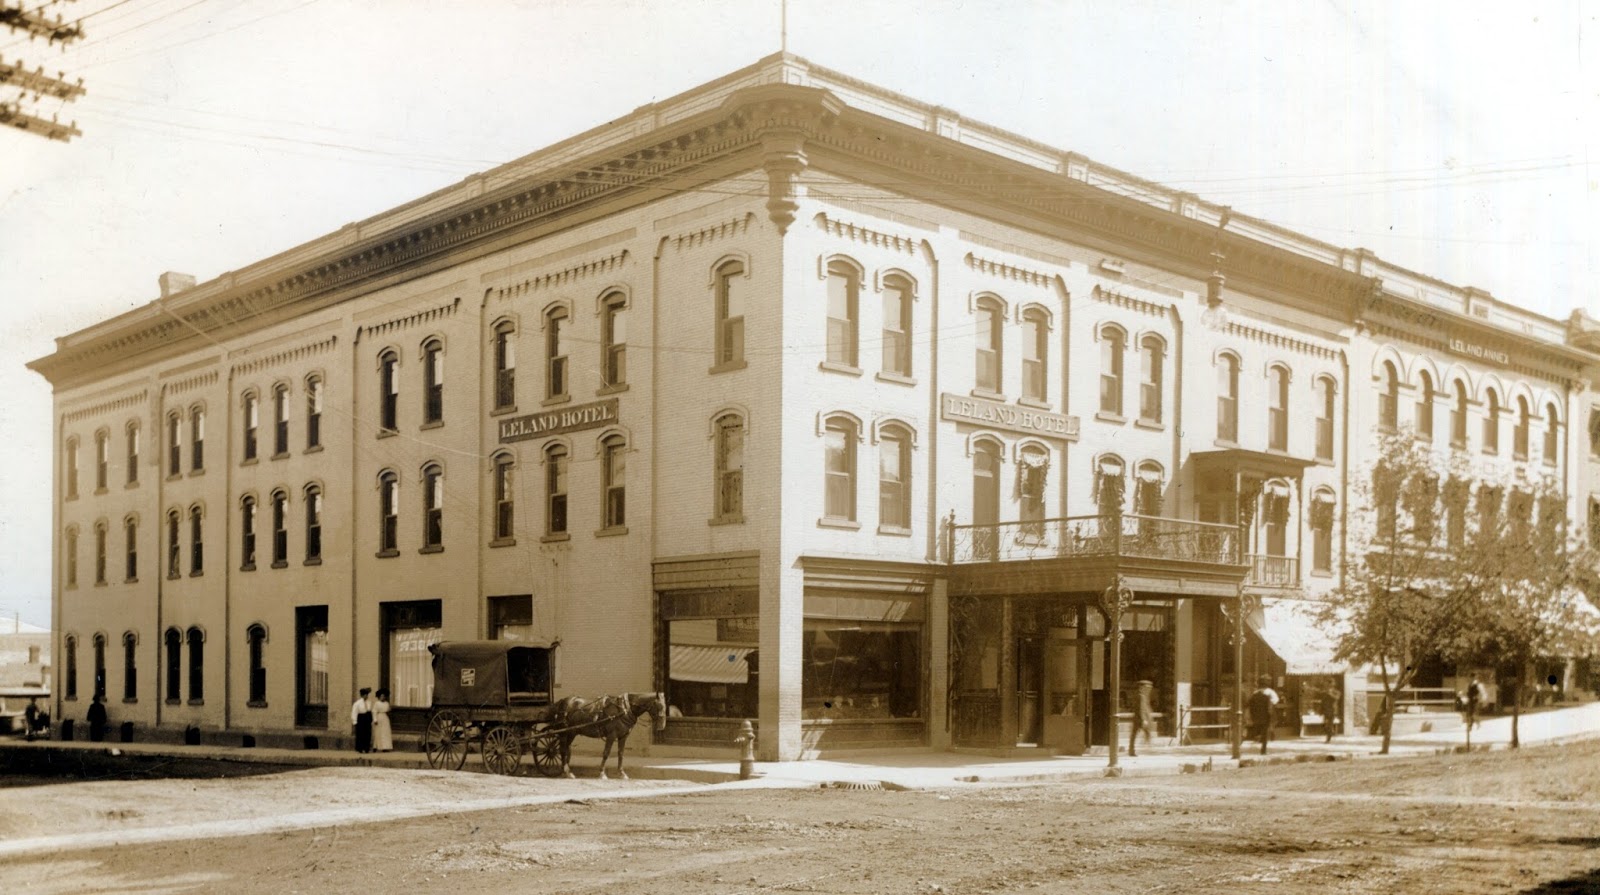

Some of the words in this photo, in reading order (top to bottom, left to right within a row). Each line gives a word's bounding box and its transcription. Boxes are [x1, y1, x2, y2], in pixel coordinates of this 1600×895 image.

[1449, 338, 1482, 357] LELAND
[1483, 348, 1509, 365] ANNEX
[501, 414, 558, 438] LELAND
[561, 405, 614, 428] HOTEL
[948, 399, 1017, 426] LELAND
[1020, 411, 1078, 436] HOTEL
